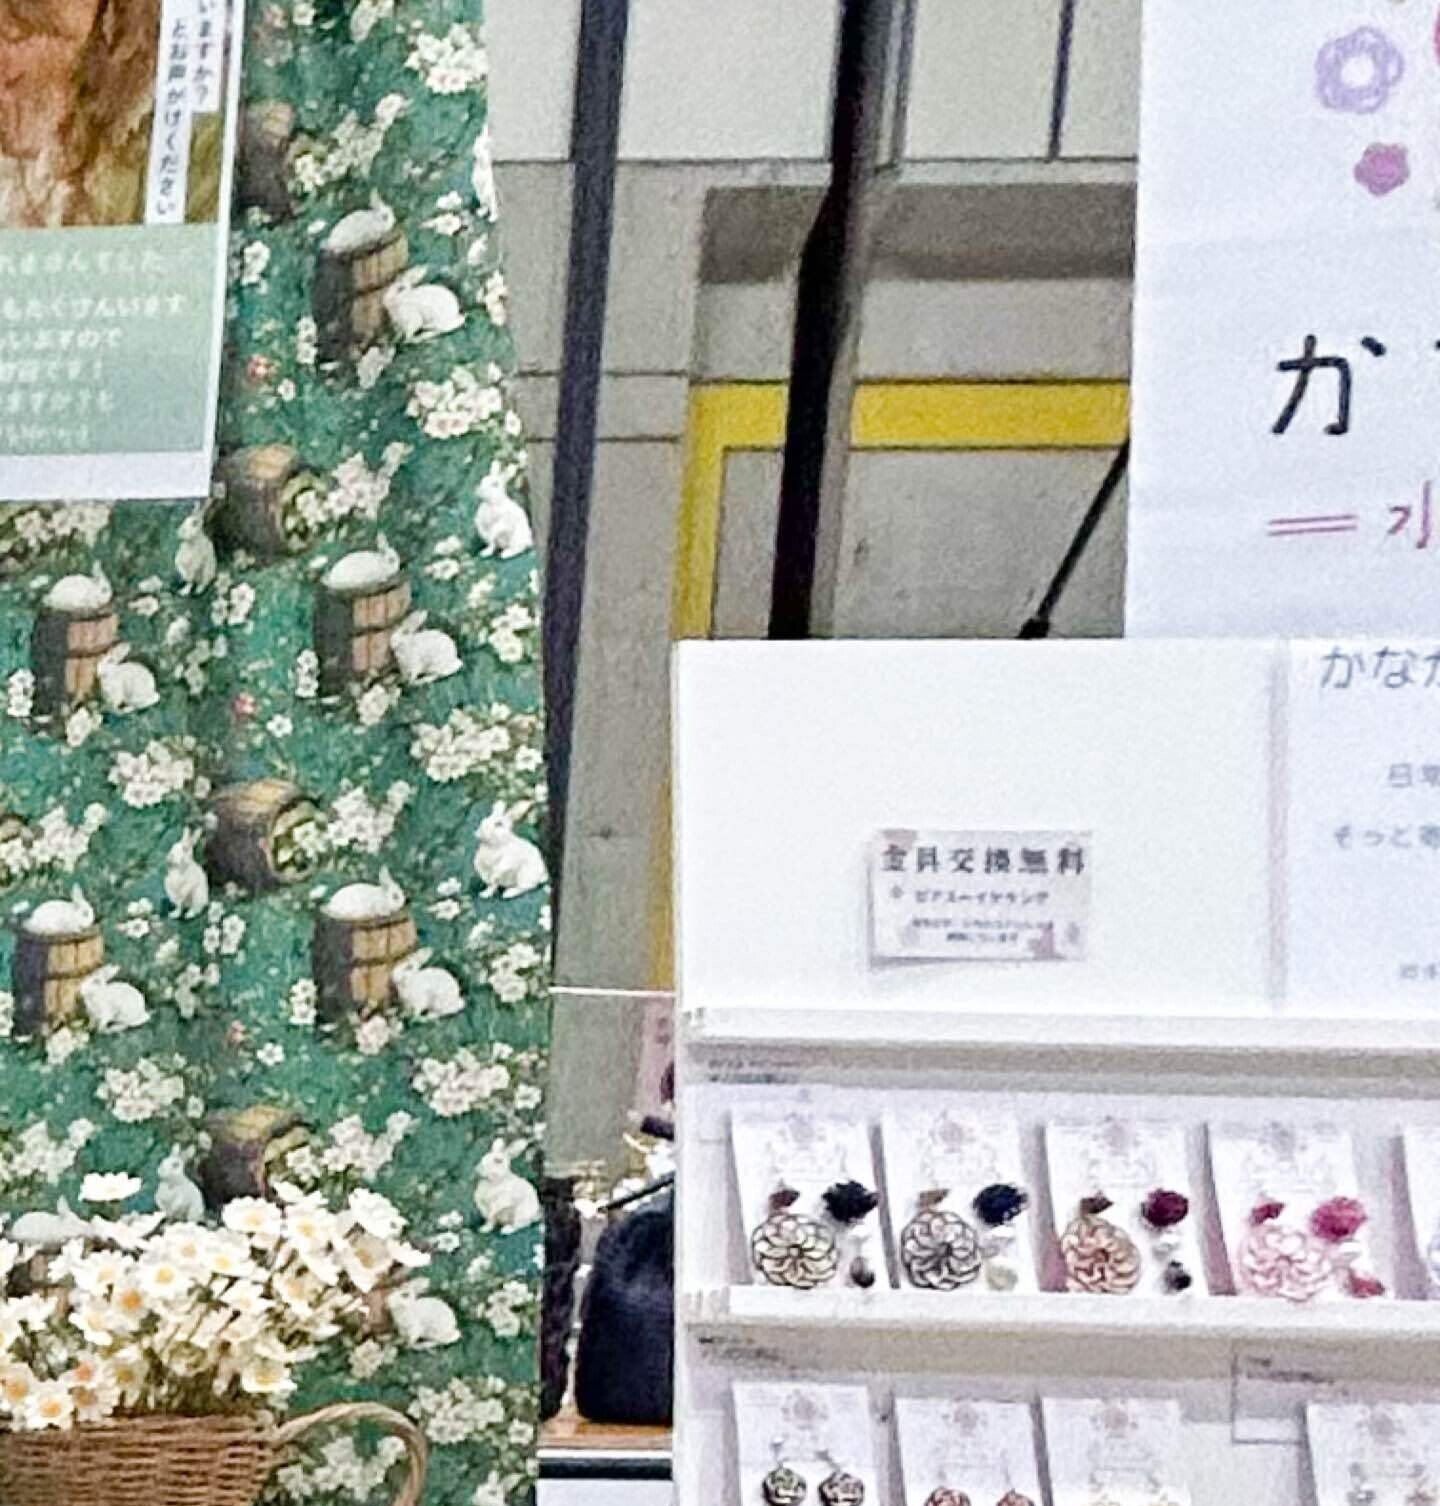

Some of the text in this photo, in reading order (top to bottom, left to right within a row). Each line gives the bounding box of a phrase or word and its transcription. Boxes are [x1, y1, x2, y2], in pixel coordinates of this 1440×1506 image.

[1272, 334, 1440, 437] か
[881, 844, 1085, 875] 金具交換無料
